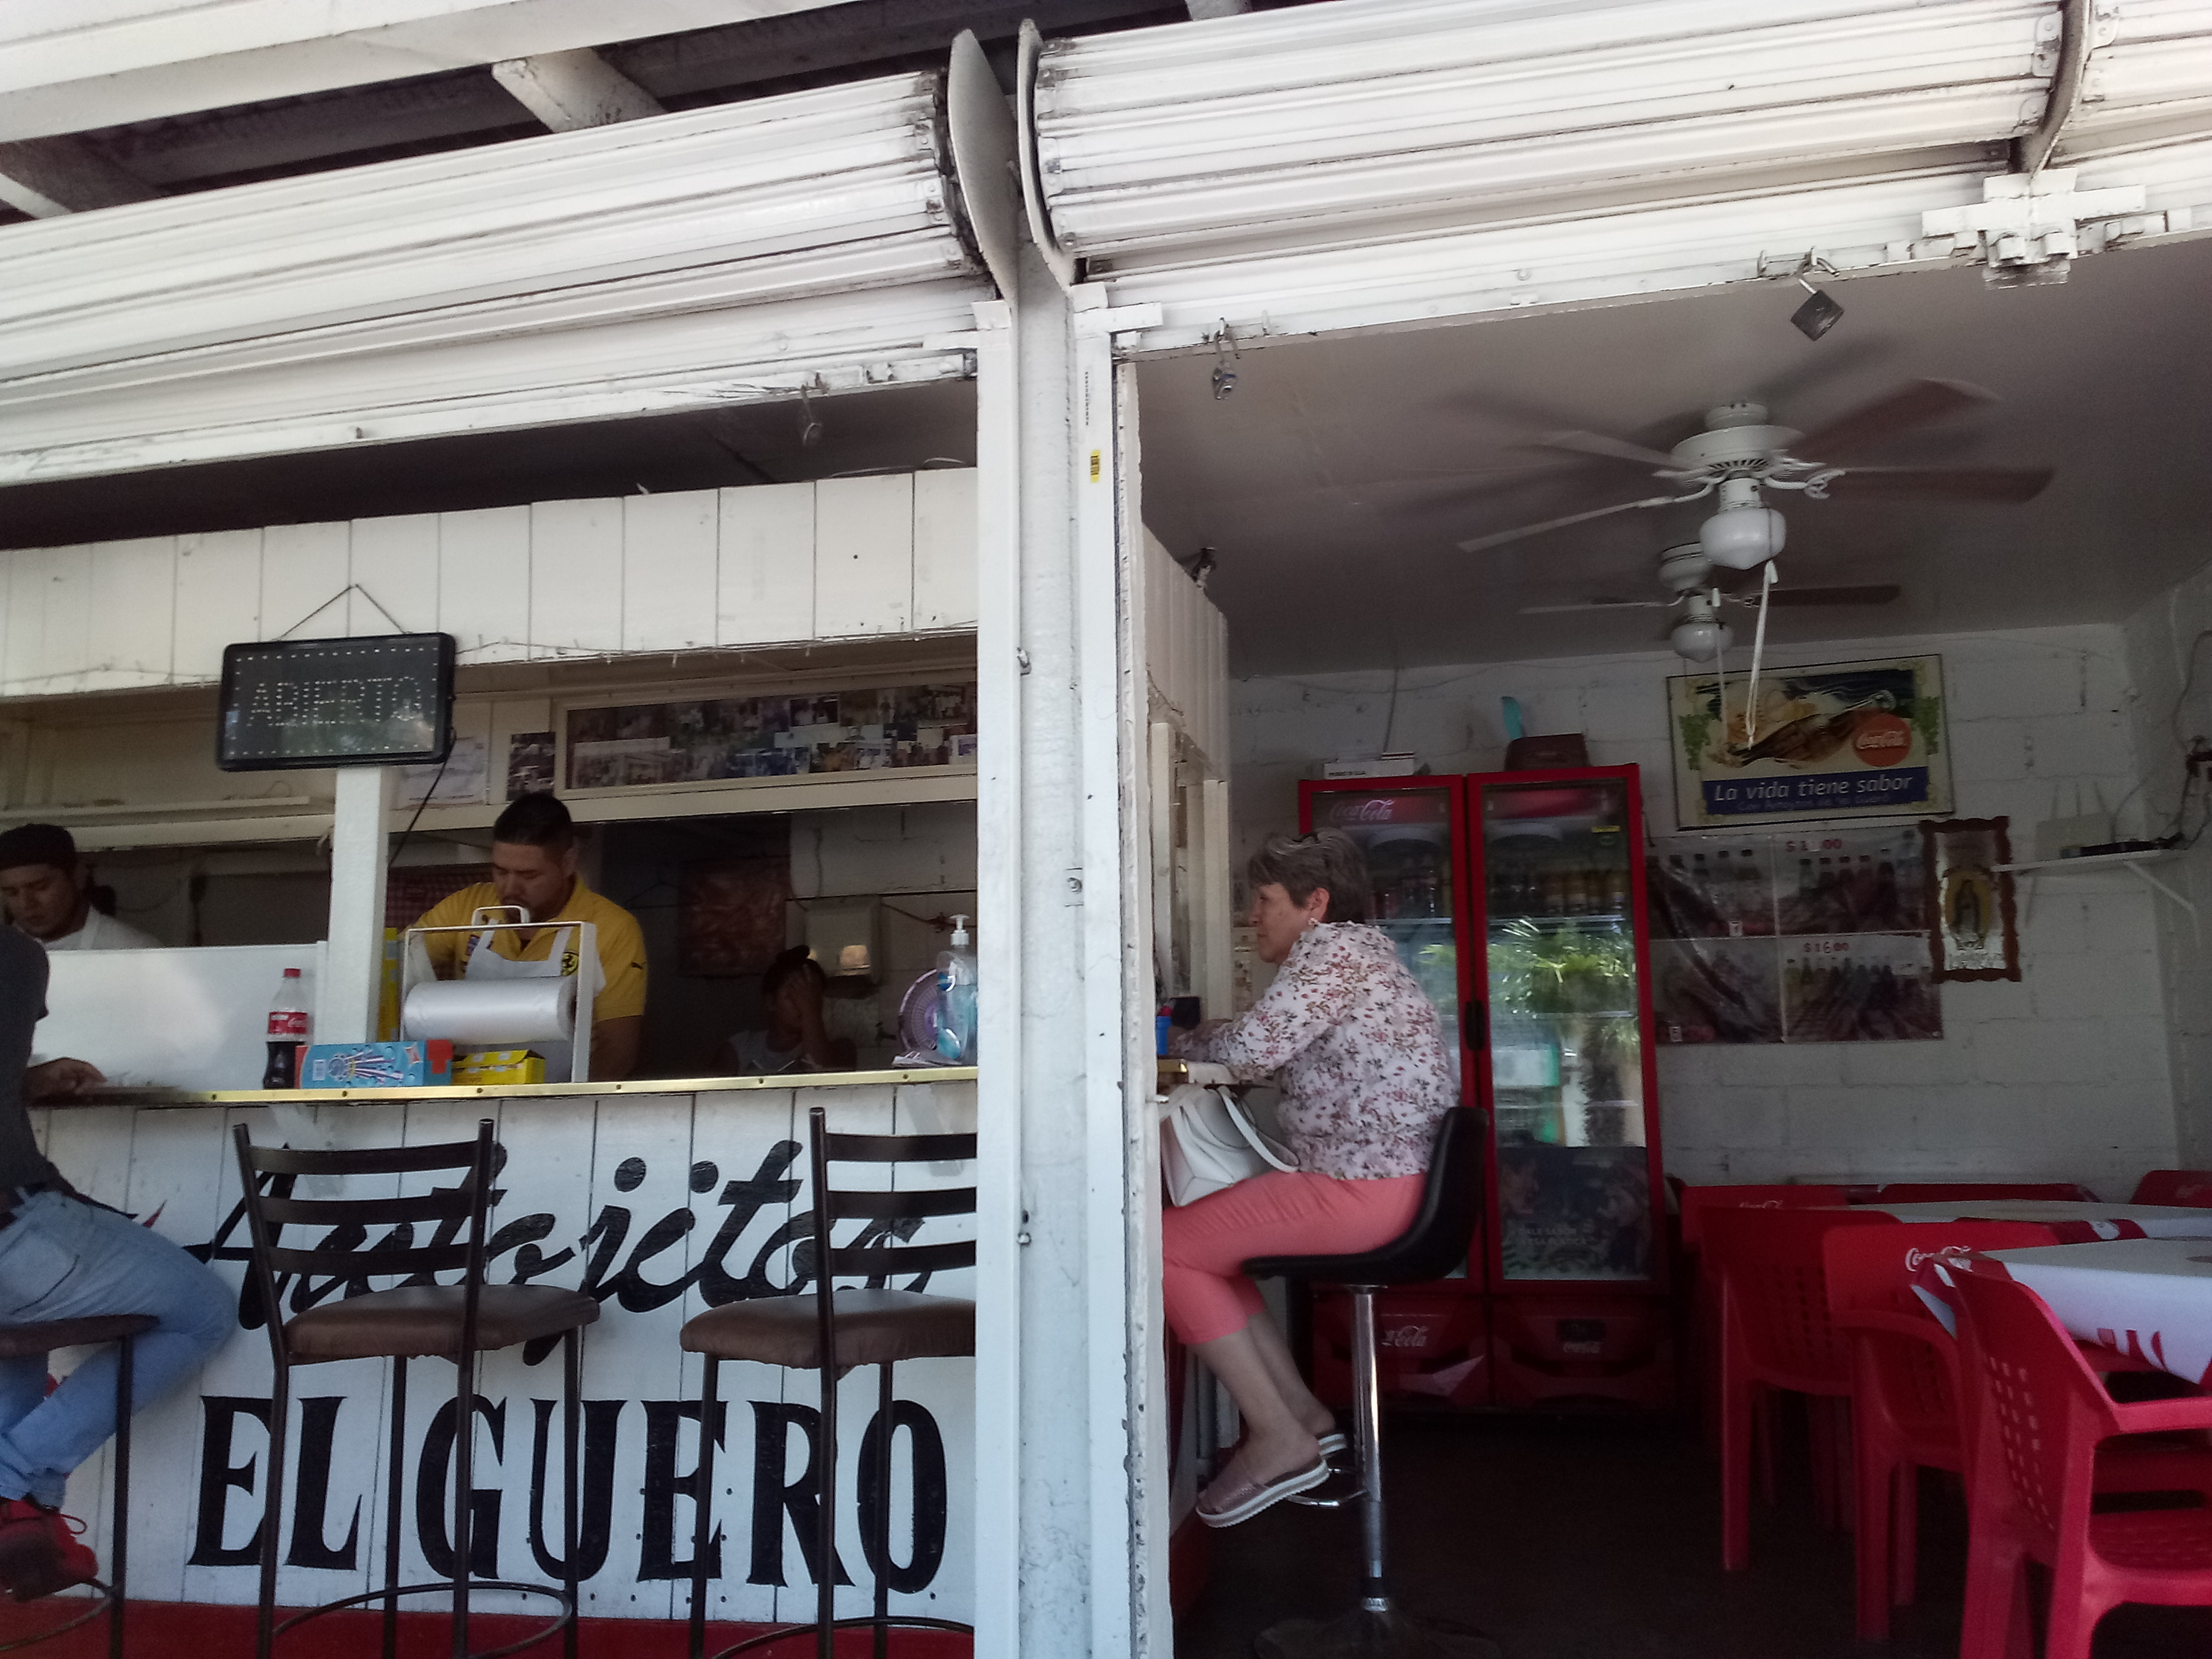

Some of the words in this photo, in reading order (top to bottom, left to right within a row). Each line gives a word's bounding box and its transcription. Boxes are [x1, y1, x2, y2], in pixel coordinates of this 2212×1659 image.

[246, 675, 423, 727] ABIERTO
[1714, 785, 1738, 801] La
[1746, 781, 1790, 800] vida
[1798, 778, 1850, 797] tiene
[1856, 774, 1913, 793] sabor
[186, 1395, 363, 1571] EL
[415, 1393, 948, 1594] GUERO
